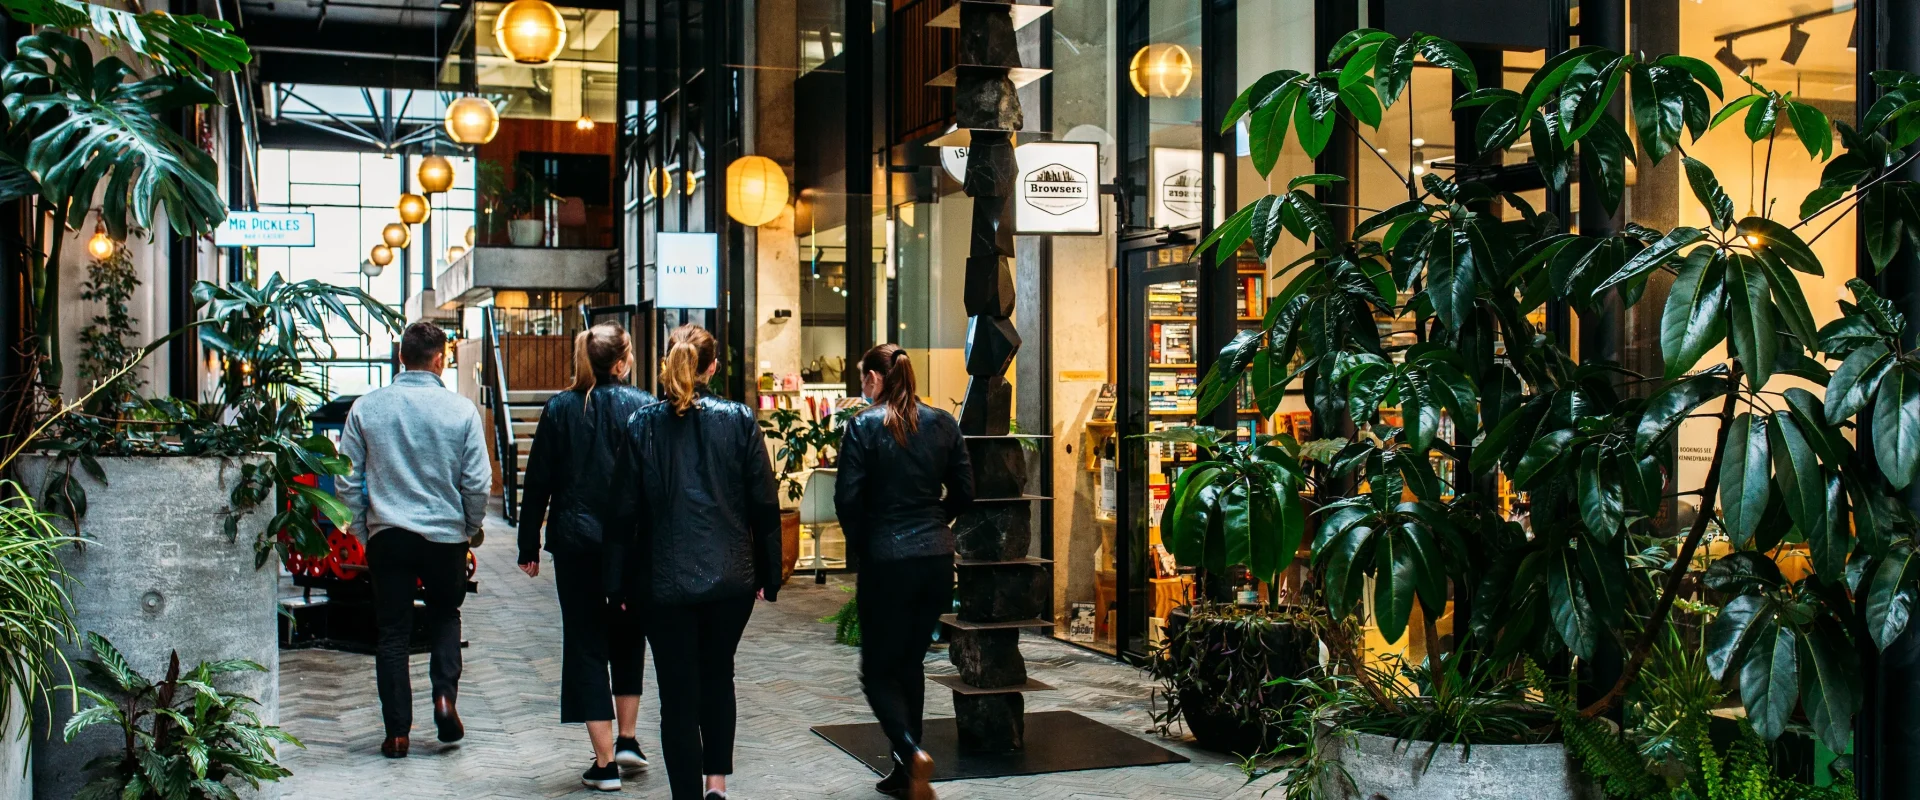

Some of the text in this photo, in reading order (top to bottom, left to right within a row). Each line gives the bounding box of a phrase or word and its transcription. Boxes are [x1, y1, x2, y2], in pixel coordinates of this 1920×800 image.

[1030, 183, 1082, 193] Browsers
[252, 218, 300, 231] PICKLES
[1680, 446, 1703, 454] BOOKINGS
